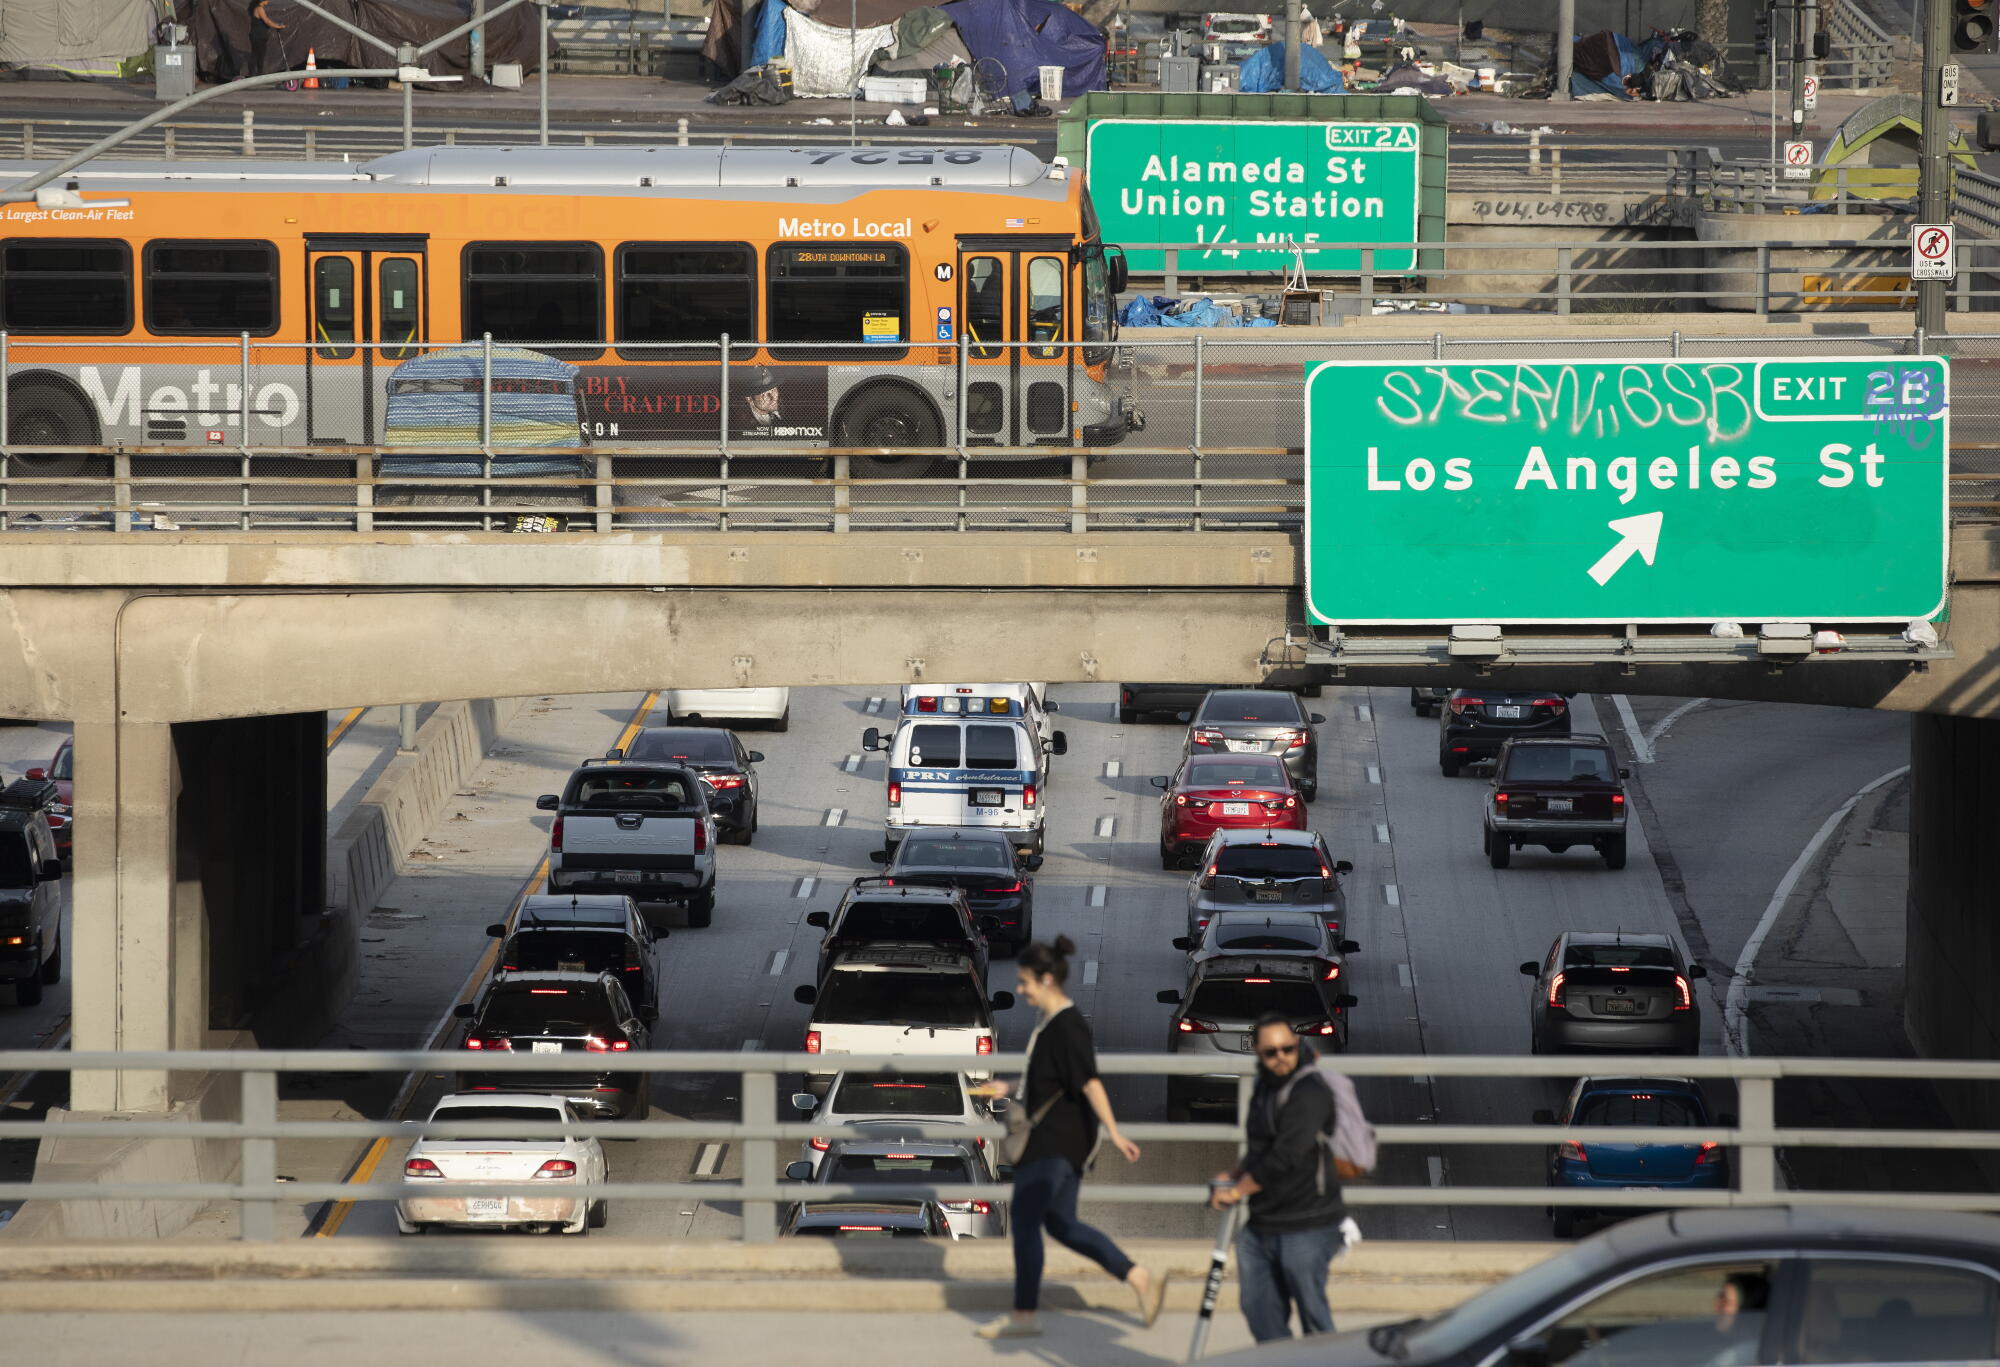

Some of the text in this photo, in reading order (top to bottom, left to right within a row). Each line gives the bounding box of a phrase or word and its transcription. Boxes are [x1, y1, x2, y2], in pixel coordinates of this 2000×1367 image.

[1944, 67, 1957, 77] BUS
[1943, 80, 1957, 89] ONLY
[1331, 127, 1414, 147] EXIT 2A
[1141, 155, 1367, 184] Alameda St
[1121, 188, 1384, 218] Union Station
[7, 210, 48, 223] Largest
[51, 209, 104, 220] Clean-Air
[106, 209, 134, 220] Fleet
[778, 218, 912, 237] Metro Local
[1256, 232, 1320, 254] MILE
[830, 253, 872, 262] DOWNTOWN
[875, 253, 886, 262] LA
[937, 266, 951, 279] M
[1916, 269, 1949, 277] CROSSWALK
[576, 376, 630, 395] BLY
[1773, 371, 1930, 405] EXIT 2B
[79, 366, 300, 428] Metro
[603, 394, 721, 413] CRAFTED
[1367, 443, 1885, 504] Los Angeles St
[905, 771, 1018, 782] PRN Ambulance
[976, 808, 999, 816] M-96
